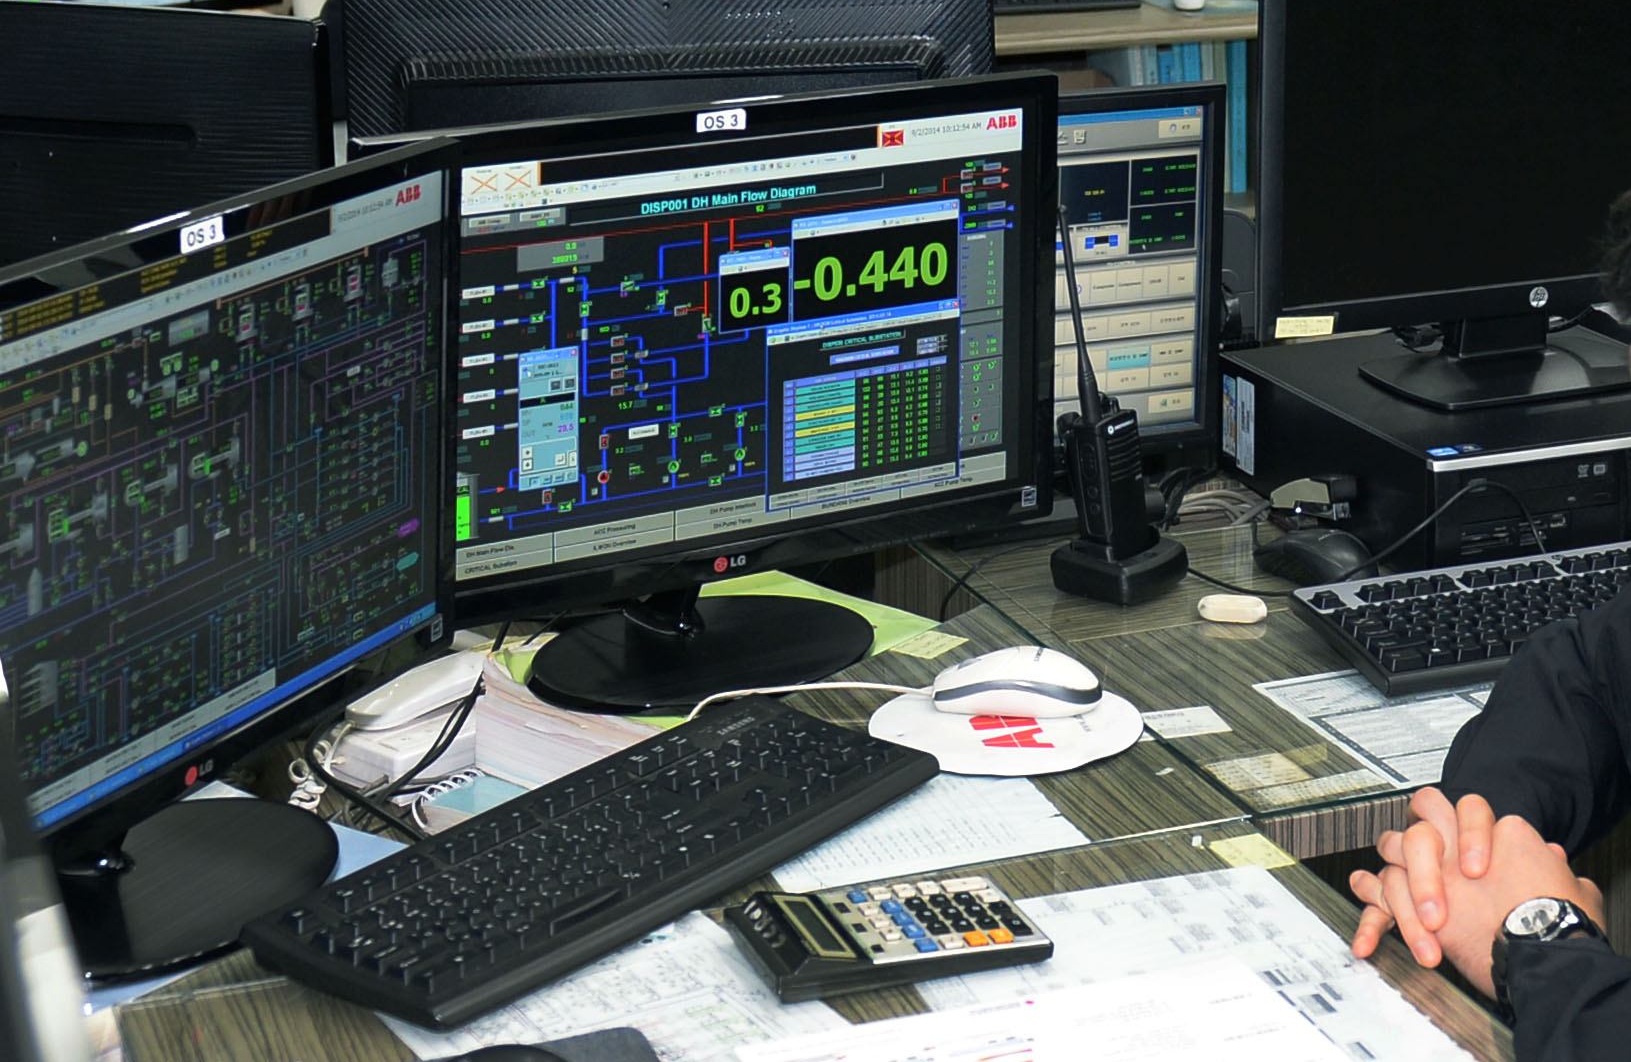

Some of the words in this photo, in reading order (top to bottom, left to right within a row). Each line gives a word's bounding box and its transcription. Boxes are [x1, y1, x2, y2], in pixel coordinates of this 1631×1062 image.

[703, 115, 726, 130] OS
[729, 114, 739, 128] 3
[986, 114, 1018, 131] ABB
[395, 184, 422, 207] ABB
[641, 197, 688, 216] DISP001
[691, 195, 709, 210] DH
[712, 192, 739, 207] Main
[741, 189, 769, 203] Flow
[770, 183, 817, 200] Diagram
[186, 228, 205, 247] OS
[209, 224, 217, 240] 3
[793, 242, 948, 301] -0.440
[729, 282, 782, 319] 0.3
[730, 555, 746, 568] LG
